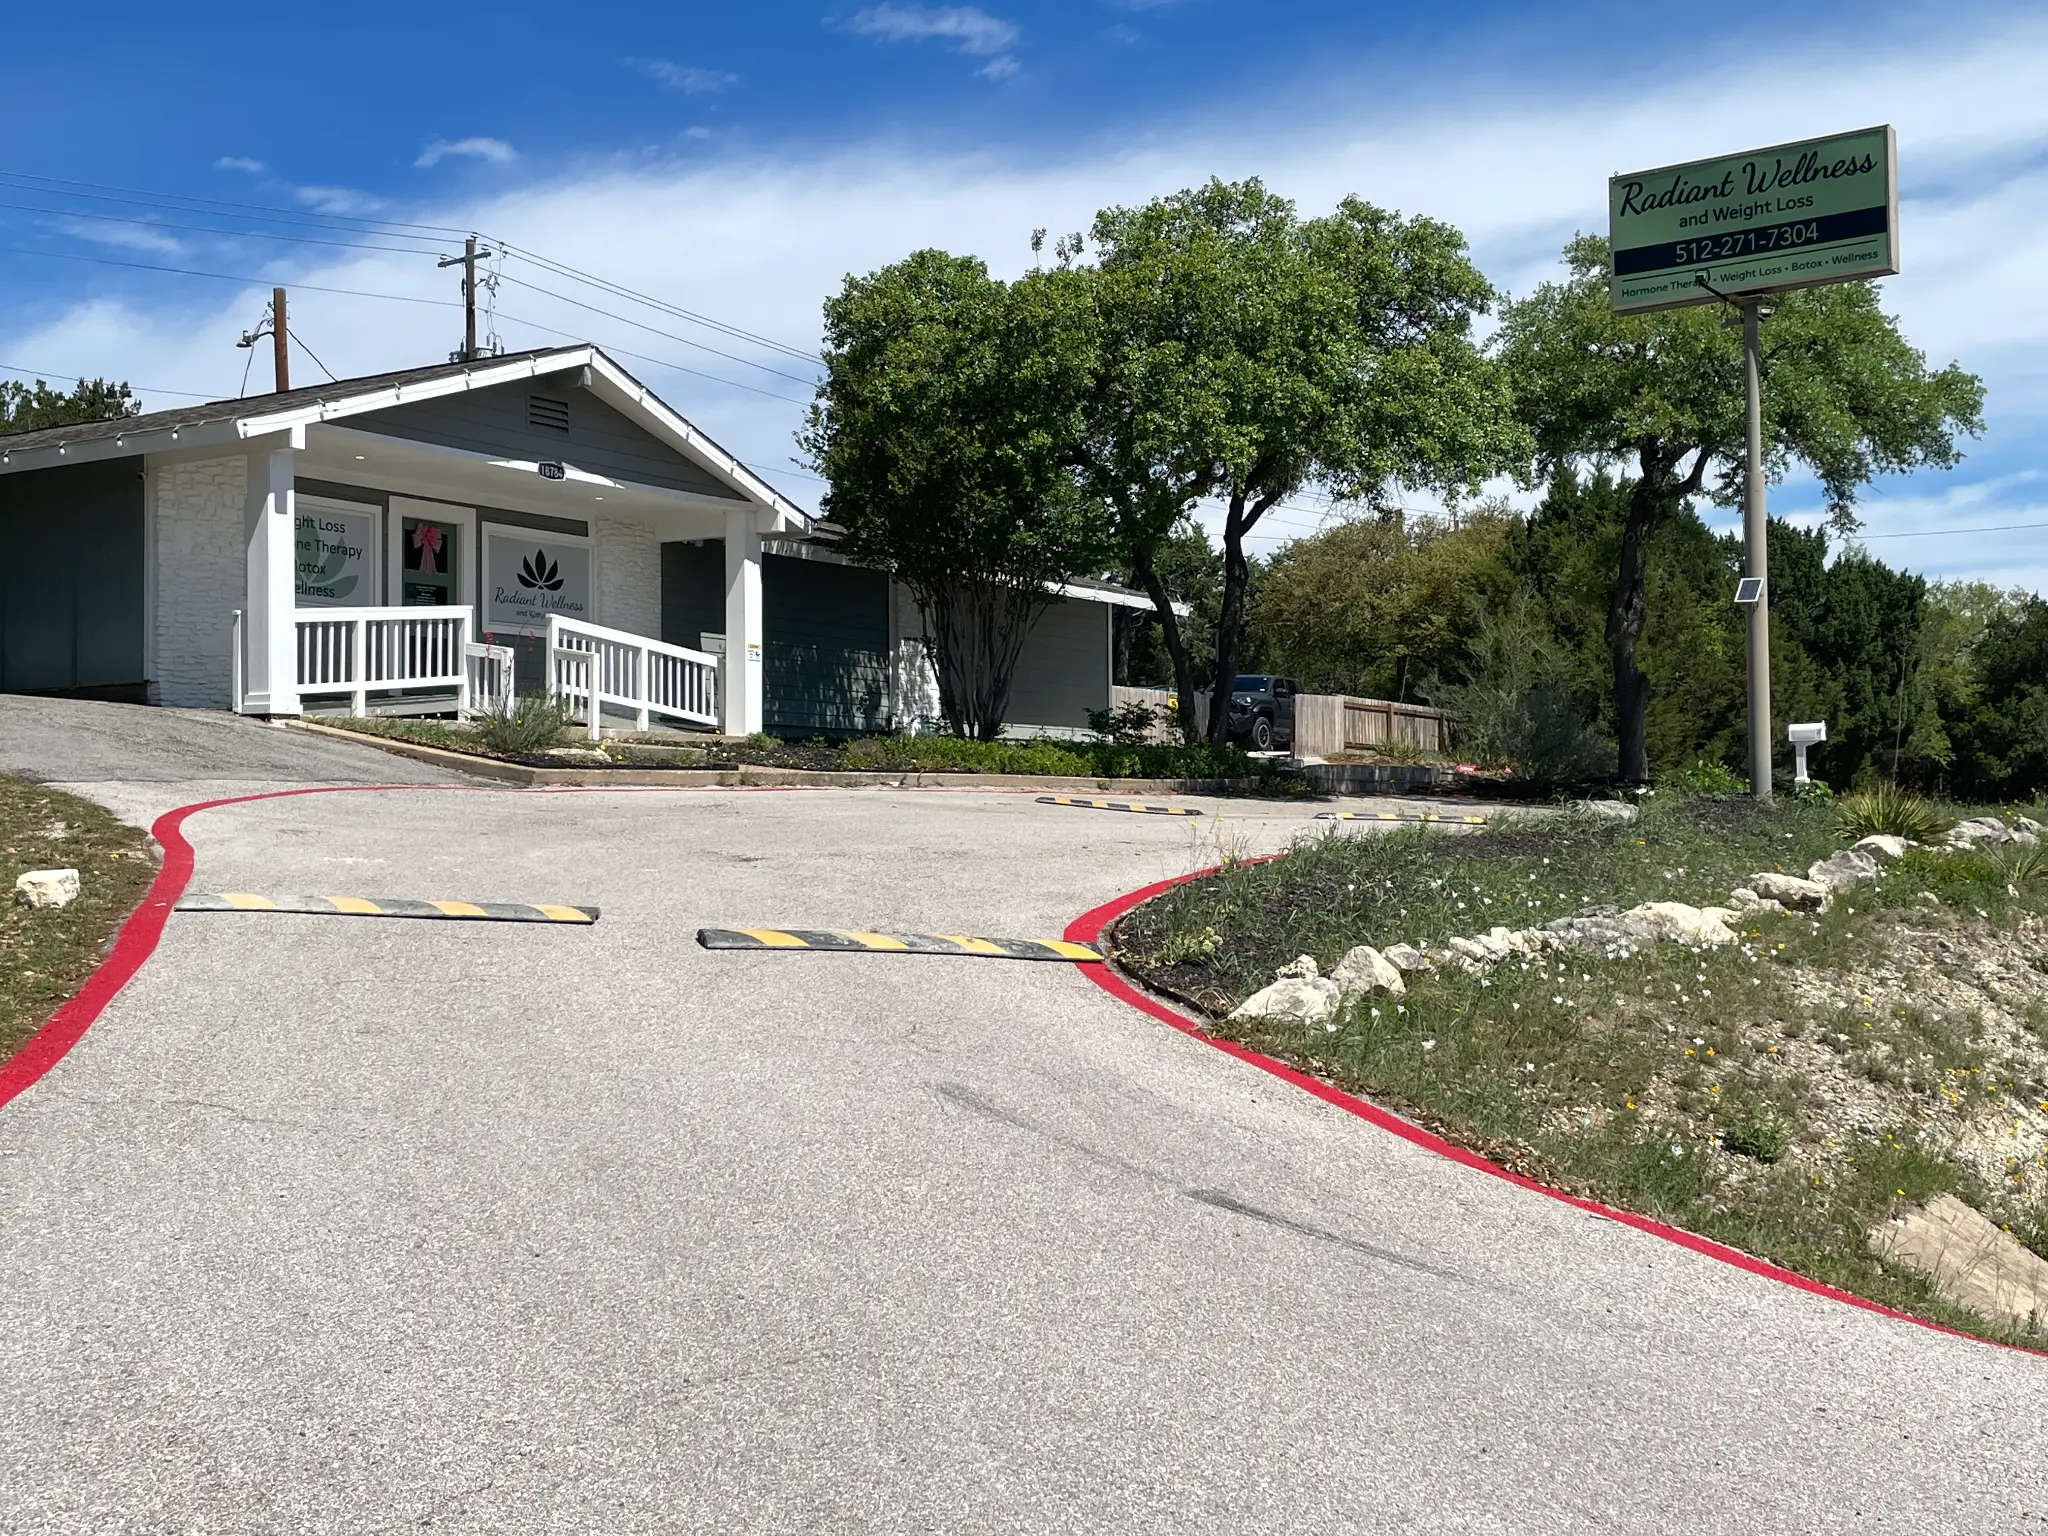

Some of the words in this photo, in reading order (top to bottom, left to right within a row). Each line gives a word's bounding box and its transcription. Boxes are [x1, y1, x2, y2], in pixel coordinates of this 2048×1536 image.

[1619, 171, 1734, 217] Radiant
[1742, 151, 1877, 194] Wellness
[1679, 211, 1708, 228] and
[1713, 199, 1772, 221] Weight
[1777, 195, 1814, 211] Loss
[1676, 222, 1819, 263] 512-271-7304
[1621, 284, 1668, 298] Hormone
[1670, 277, 1704, 290] Thera
[1720, 269, 1756, 283] Weight
[1759, 266, 1782, 277] Loss
[1791, 260, 1822, 272] Botox
[1831, 250, 1878, 265] Wellness
[319, 517, 346, 533] Loss
[314, 539, 363, 560] Therapy
[295, 559, 327, 575] otox
[295, 581, 335, 598] ellness
[494, 586, 537, 607] Radiant
[540, 592, 584, 612] Wellness
